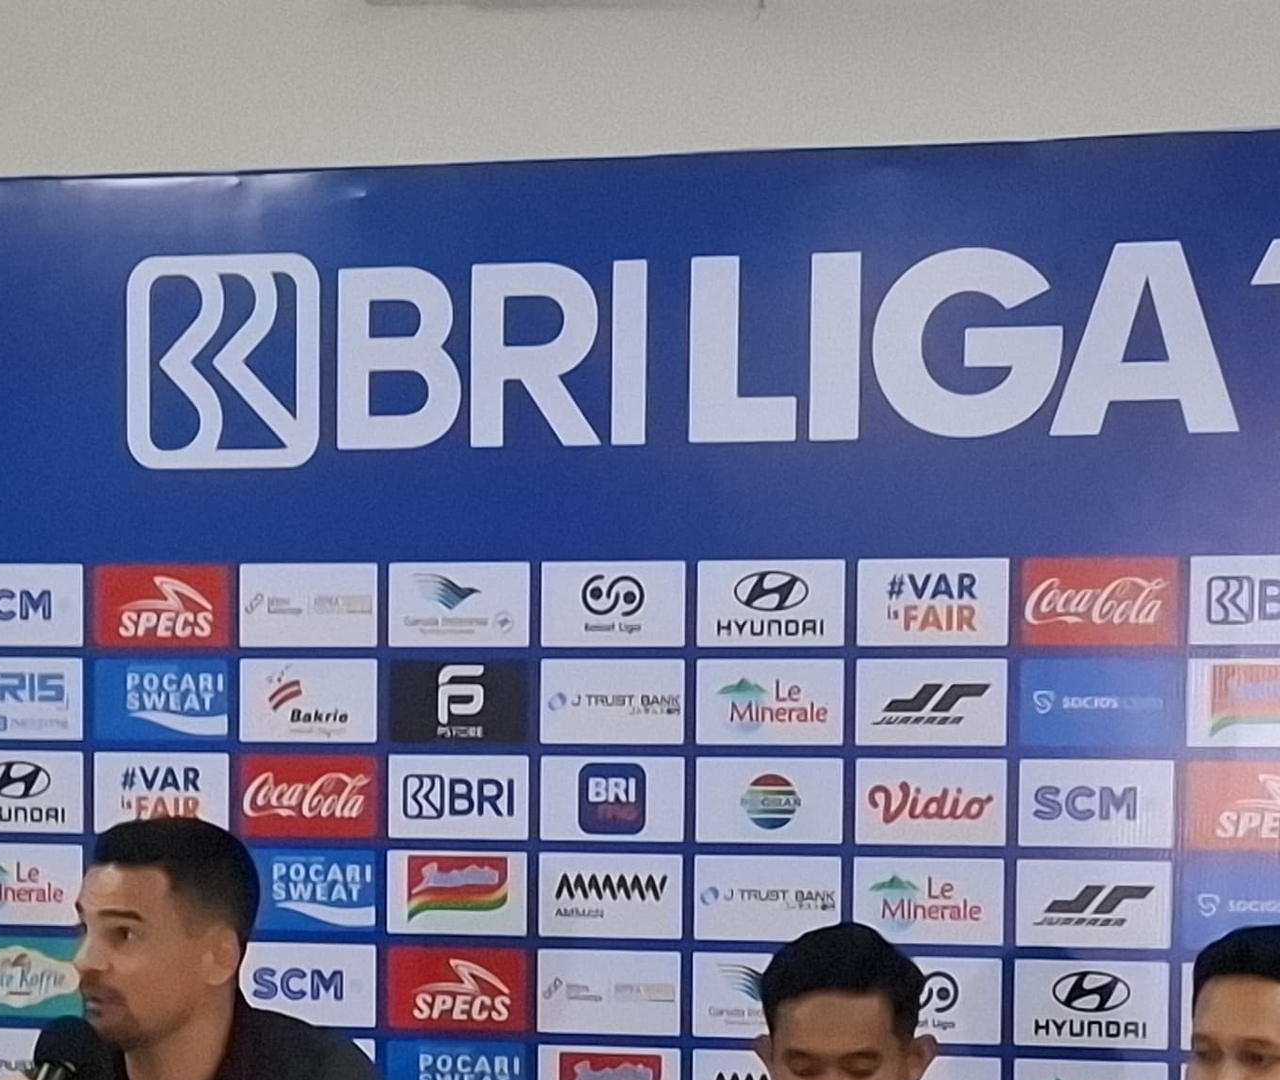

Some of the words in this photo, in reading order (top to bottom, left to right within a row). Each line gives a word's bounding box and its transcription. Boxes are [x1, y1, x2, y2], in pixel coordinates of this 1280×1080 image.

[337, 258, 648, 451] BRI
[689, 240, 1240, 442] LIGA
[888, 574, 976, 599] #VAR
[119, 611, 212, 637] SPECS
[717, 620, 823, 636] HYUNDAI
[904, 605, 976, 631] FAIR
[127, 673, 223, 692] POCARI
[775, 679, 800, 702] Le
[127, 692, 214, 712] SWEAT
[584, 694, 637, 708] TRUST
[643, 694, 679, 708] BANK
[730, 701, 828, 722] Minerale
[290, 709, 348, 725] Bakrie
[121, 766, 200, 791] #VAR
[589, 778, 635, 802] BRI
[135, 796, 200, 819] FAIR
[448, 778, 514, 817] BRI
[868, 780, 993, 824] Vidio
[1033, 785, 1137, 820] SCM
[16, 859, 39, 883] Le
[272, 864, 371, 883] POCARI
[272, 883, 361, 901] SWEAT
[736, 888, 789, 902] TRUST
[795, 888, 835, 903] BANK
[928, 877, 953, 899] Le
[881, 899, 982, 920] Minerale
[253, 967, 342, 1000] SCM
[415, 993, 509, 1020] SPECS
[1034, 1019, 1146, 1039] HYUNDAI
[419, 1053, 519, 1074] POCARI
